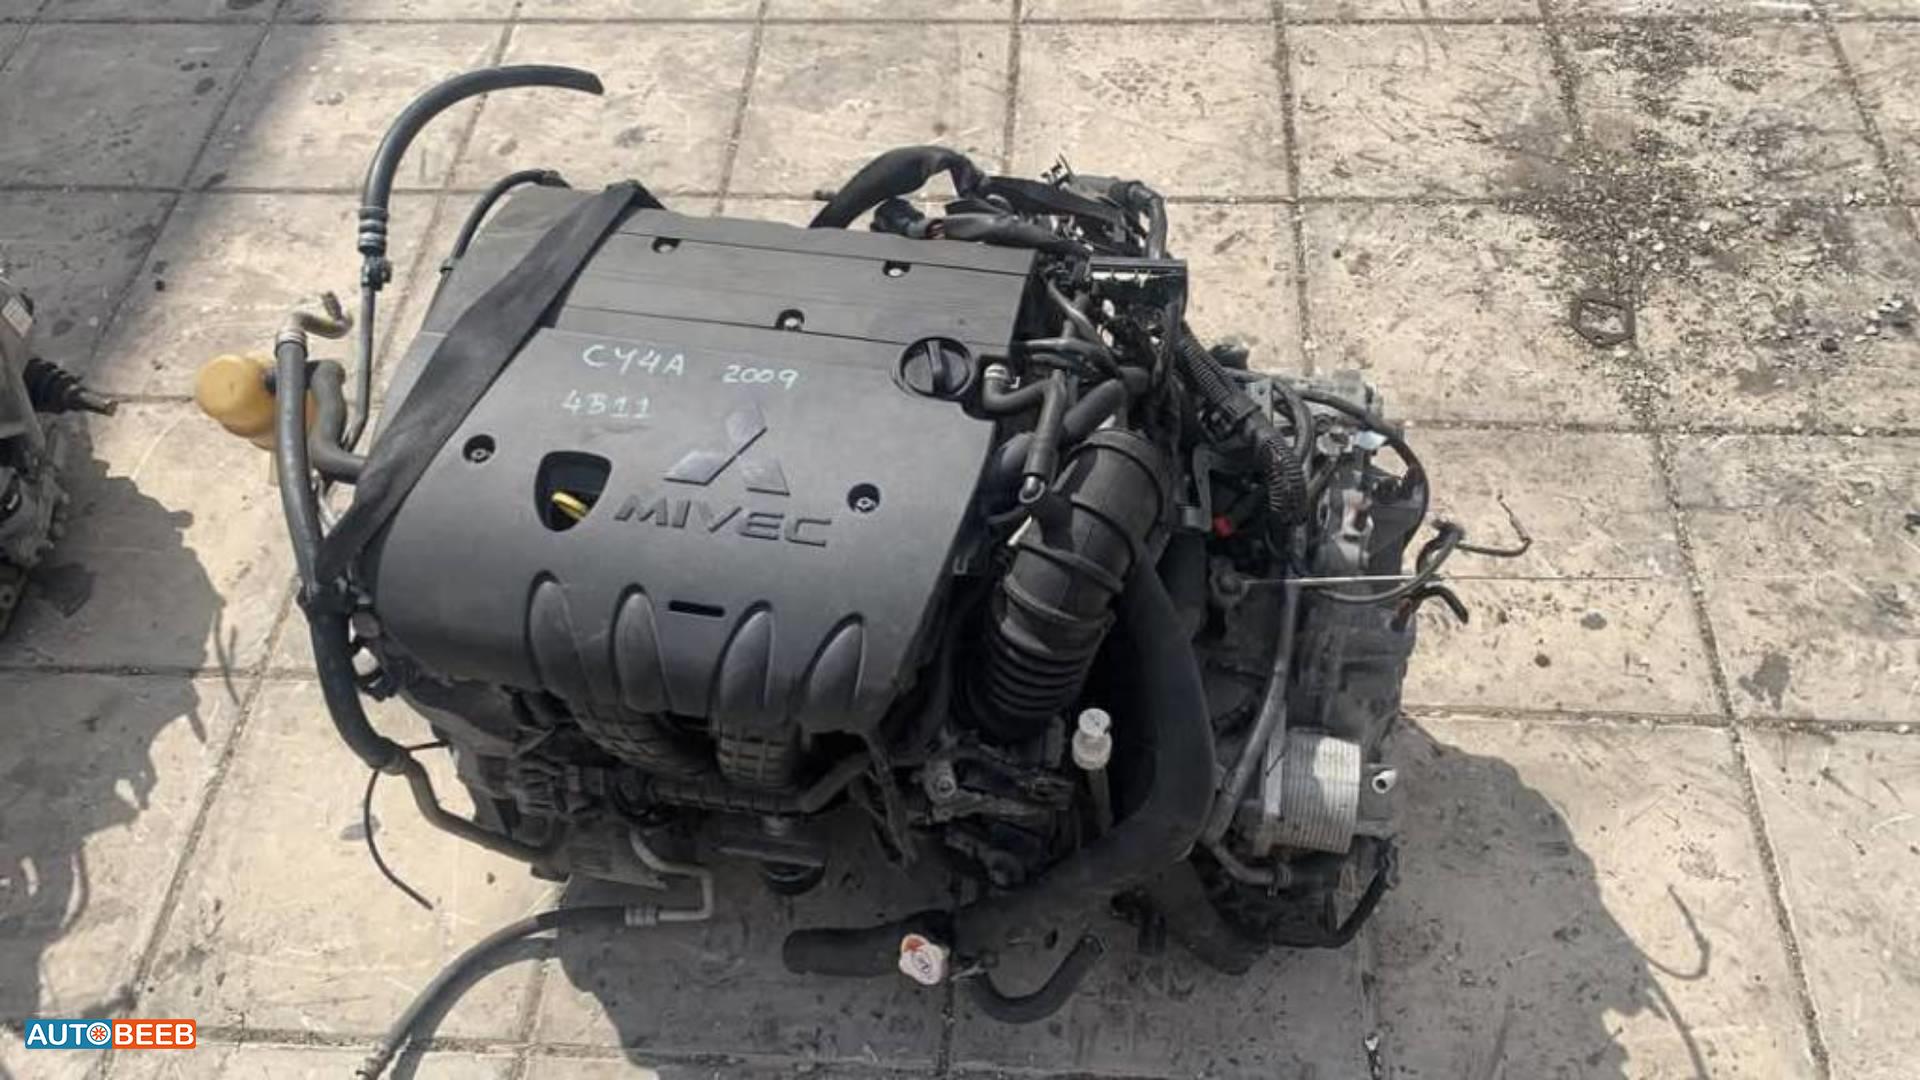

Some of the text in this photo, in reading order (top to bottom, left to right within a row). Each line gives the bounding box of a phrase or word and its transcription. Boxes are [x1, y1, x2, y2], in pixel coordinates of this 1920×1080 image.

[582, 345, 799, 391] CY4A 2009
[561, 389, 652, 419] 4B11
[613, 496, 832, 548] MIVEC
